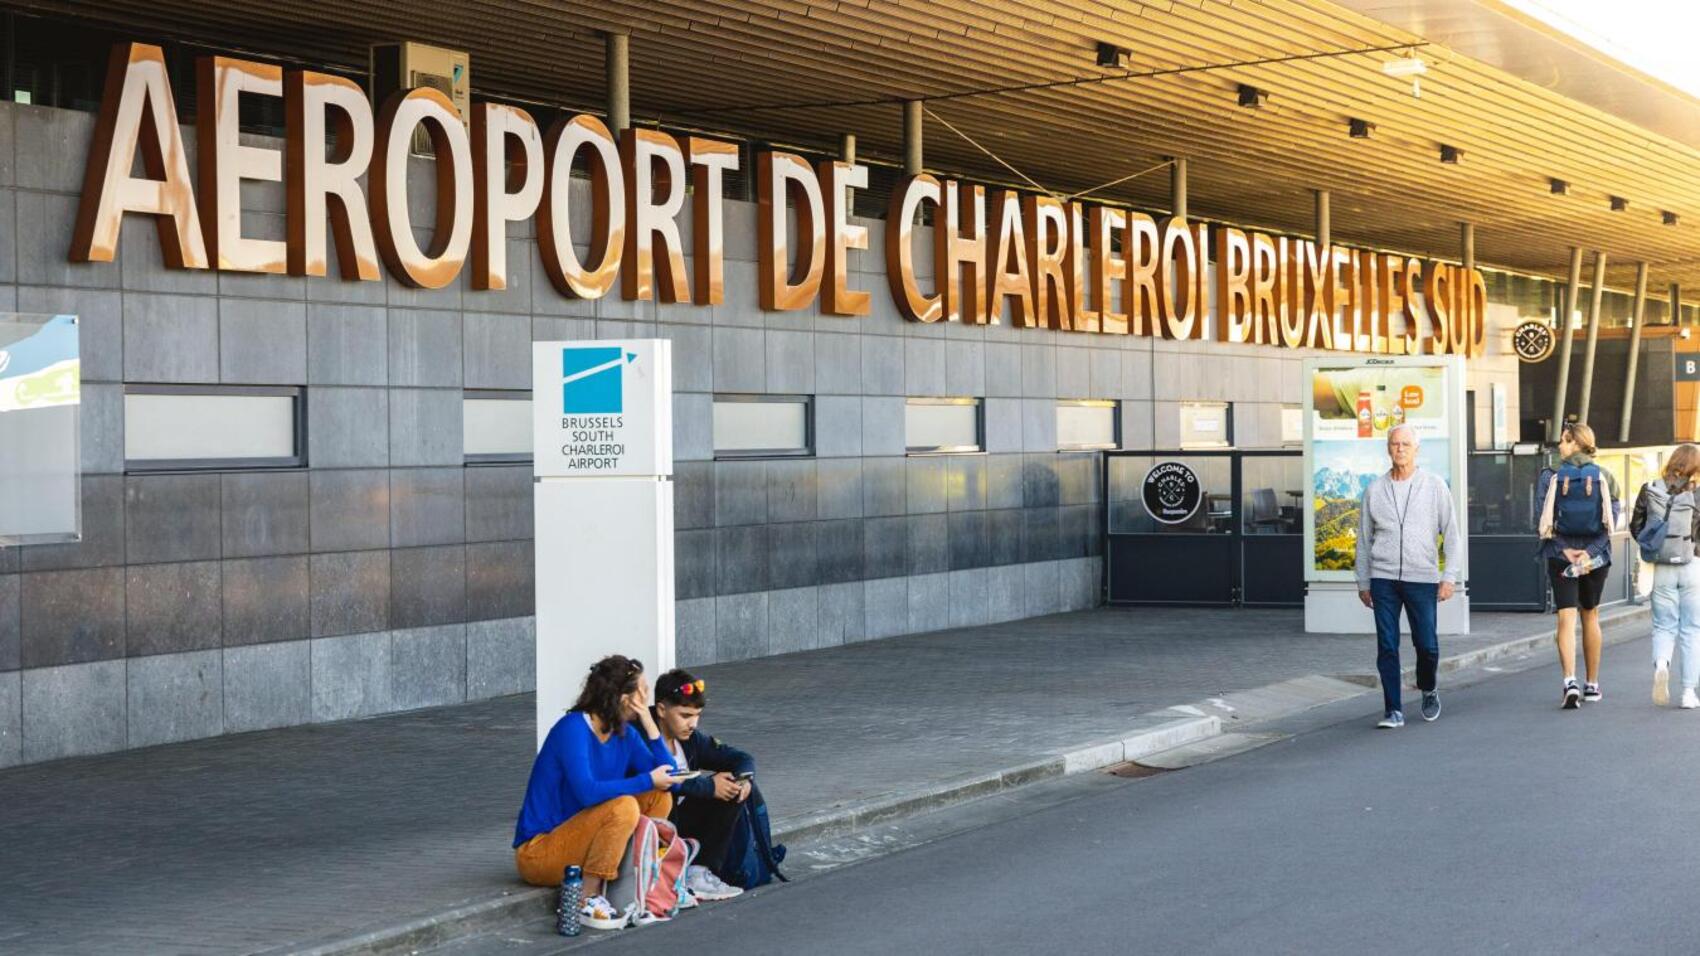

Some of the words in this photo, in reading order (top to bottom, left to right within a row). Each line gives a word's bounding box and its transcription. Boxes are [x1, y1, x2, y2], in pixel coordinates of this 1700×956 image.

[69, 42, 739, 306] AEROPORT
[758, 151, 870, 316] DE
[888, 173, 1209, 341] CHARLEROI
[1217, 226, 1421, 354] BRUXELLES
[1424, 260, 1487, 358] SUD
[1686, 361, 1695, 373] B
[562, 417, 623, 429] BRUSSELS
[572, 431, 614, 442] SOUTH
[562, 444, 624, 456] CHARLEROI
[568, 458, 619, 469] AIRPORT
[1147, 464, 1184, 483] WELCOME
[1184, 471, 1195, 483] TO
